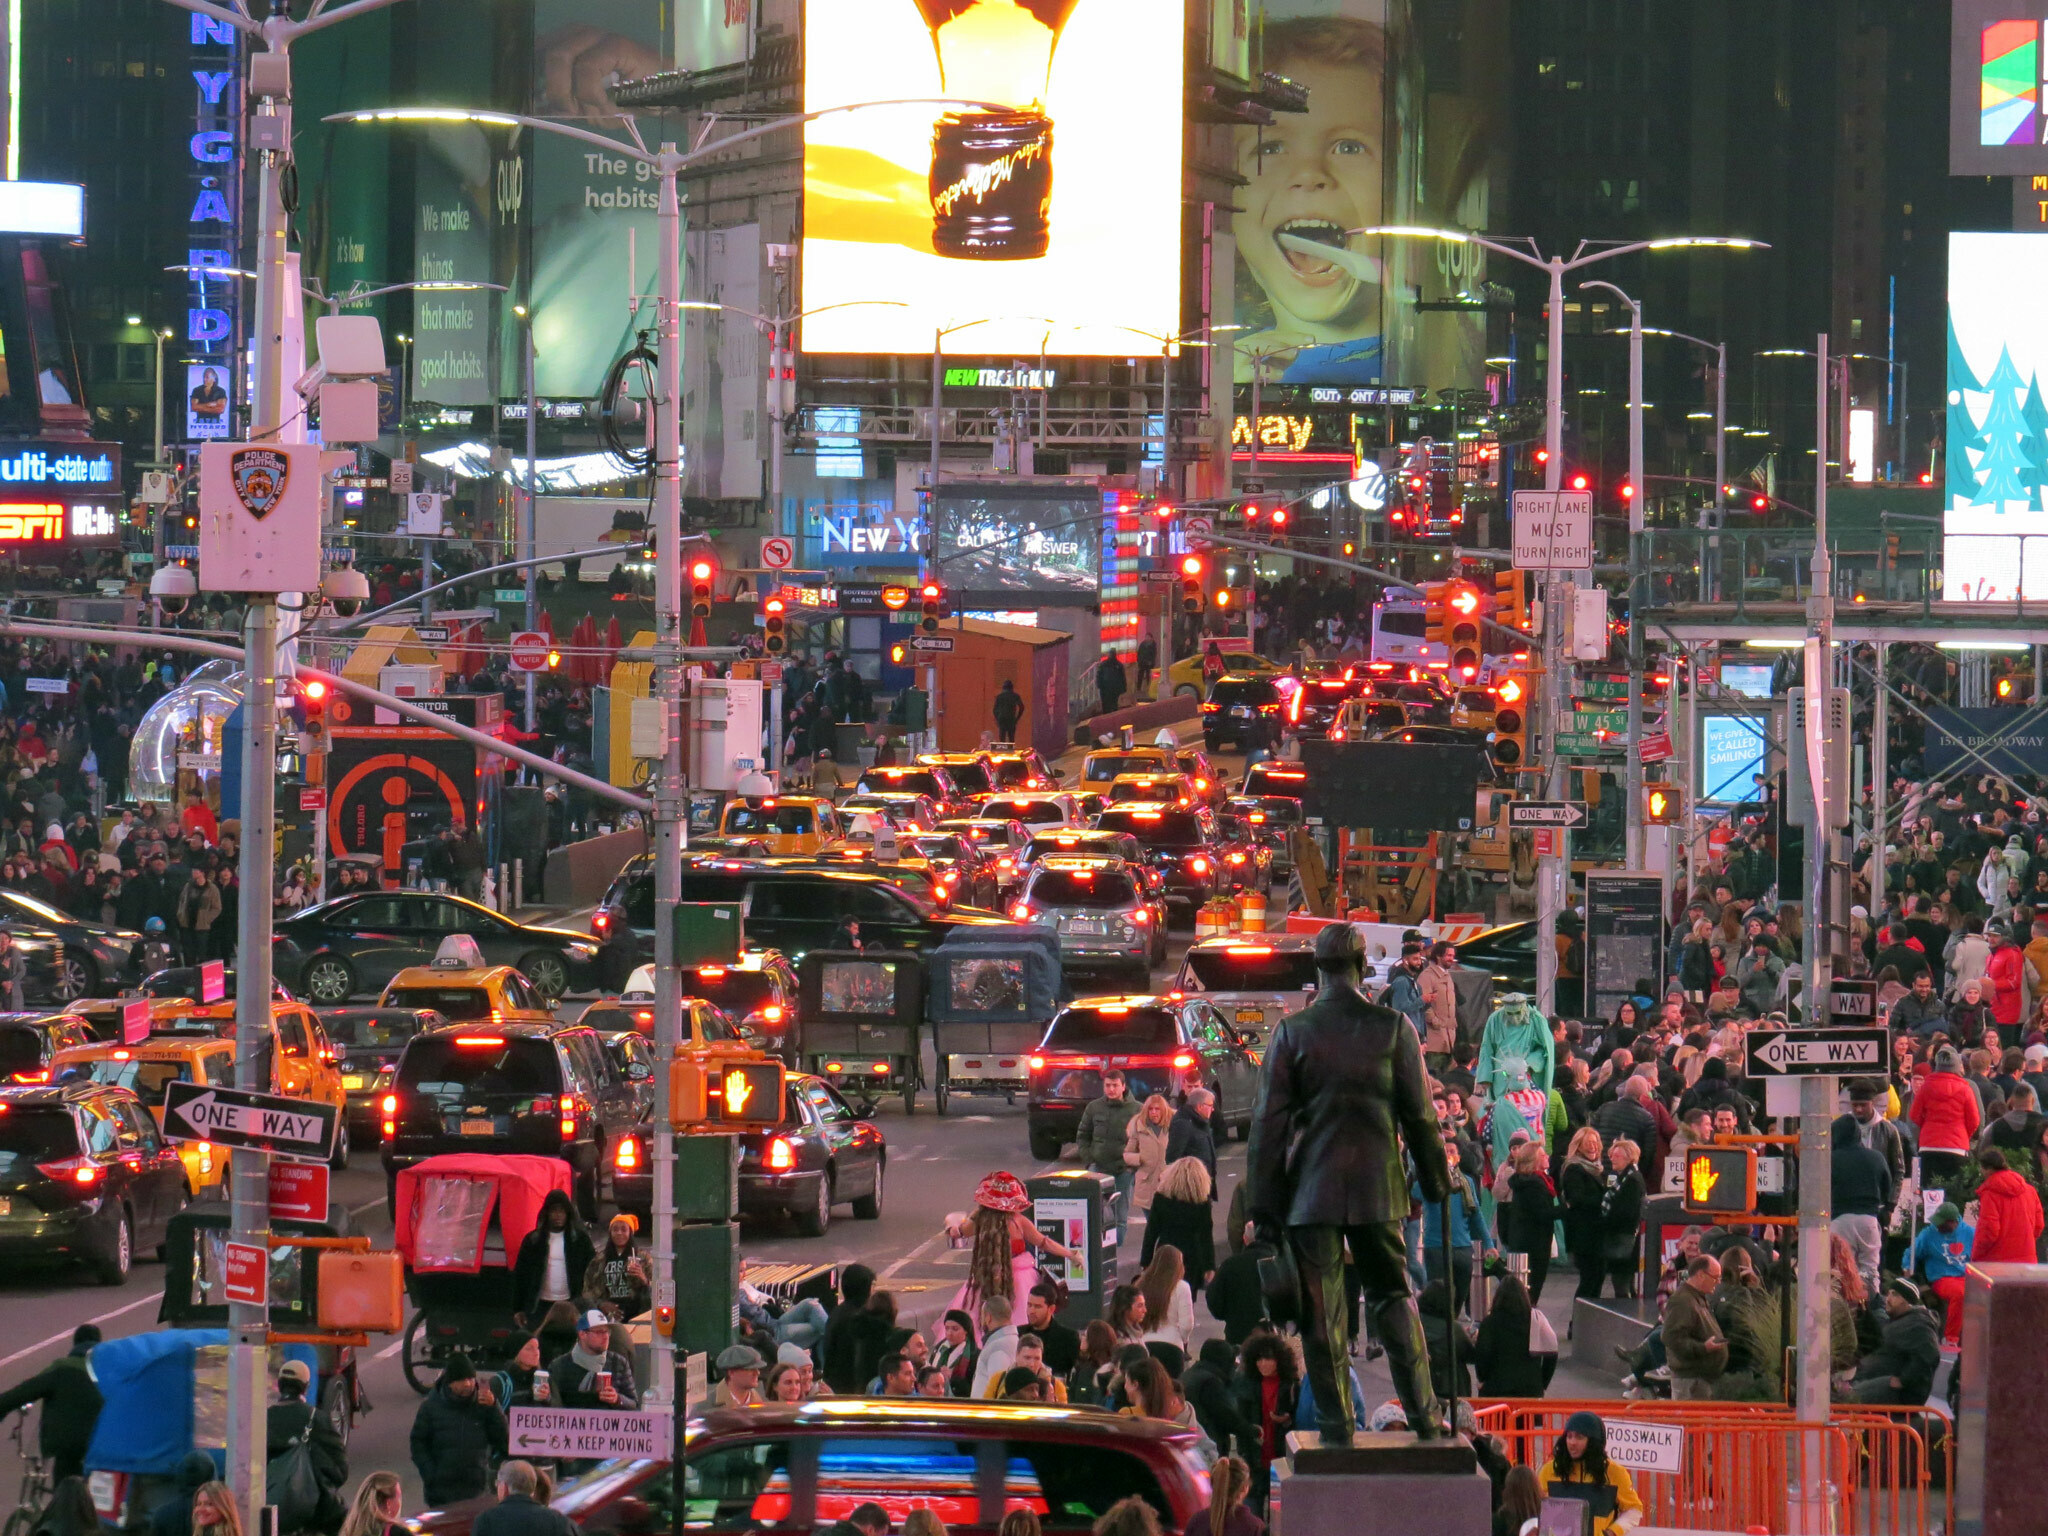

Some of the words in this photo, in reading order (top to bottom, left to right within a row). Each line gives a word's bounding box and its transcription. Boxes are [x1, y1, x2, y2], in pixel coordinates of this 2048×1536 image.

[584, 153, 627, 175] The
[585, 186, 659, 208] habits
[422, 204, 439, 231] We
[440, 202, 470, 231] make
[422, 252, 454, 281] things
[422, 302, 443, 330] that
[444, 301, 474, 330] make
[421, 350, 447, 388] good
[449, 350, 485, 379] habits.
[555, 404, 581, 417] PRIME
[244, 451, 277, 461] POLICE
[233, 458, 287, 472] DEPARTMENT
[274, 476, 286, 495] YORK
[394, 473, 410, 483] 25
[234, 479, 246, 497] CITY
[243, 498, 254, 508] OF
[263, 496, 277, 513] NEW
[1516, 502, 1551, 514] RIGHT
[1558, 501, 1588, 514] LANE
[1531, 523, 1573, 538] MUST
[323, 548, 354, 561] NYPD
[1515, 547, 1546, 559] TURN
[1553, 547, 1588, 559] RIGHT
[519, 656, 540, 664] ENTER
[1586, 683, 1597, 693] W
[1601, 683, 1615, 693] 45
[1576, 715, 1589, 730] W
[1594, 715, 1610, 730] 45
[1710, 732, 1722, 741] WE
[1724, 729, 1744, 739] GIVE
[1717, 737, 1757, 752] CALLED
[1710, 748, 1757, 765] SMILING
[1520, 809, 1543, 819] ONE
[1552, 809, 1575, 819] WAY
[1838, 995, 1865, 1013] WAY
[1768, 1044, 1809, 1063] ONE
[1827, 1043, 1871, 1062] WAY
[191, 1102, 238, 1129] ONE
[262, 1111, 313, 1139] WAY
[280, 1167, 314, 1181] STANDING
[516, 1413, 587, 1431] PEDESTRIAN
[589, 1415, 620, 1432] FLOW
[623, 1417, 653, 1434] ZONE
[576, 1435, 605, 1451] KEEP
[609, 1436, 653, 1453] MOVING
[1607, 1430, 1673, 1447] ROSSWALK
[1610, 1446, 1658, 1463] CLOSED
